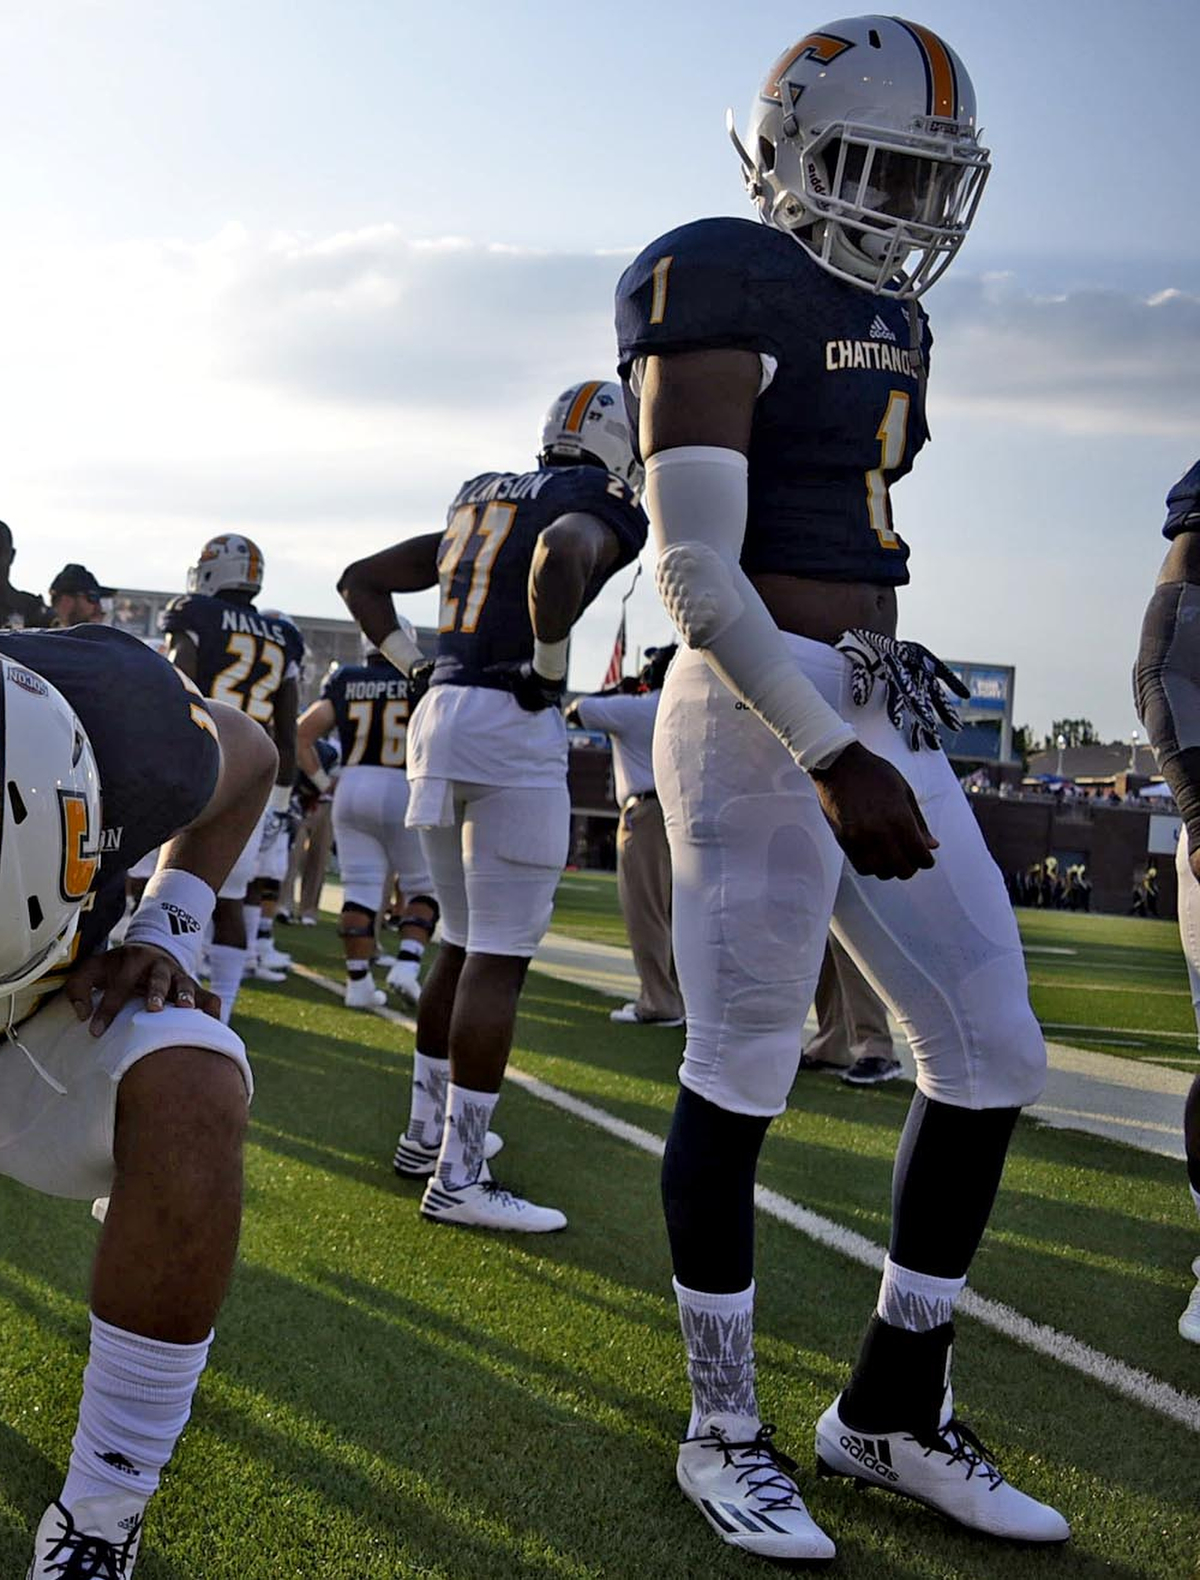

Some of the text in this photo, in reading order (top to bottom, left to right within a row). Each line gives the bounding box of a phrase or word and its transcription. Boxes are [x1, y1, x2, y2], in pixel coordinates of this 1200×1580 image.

[649, 256, 673, 324] 1
[865, 389, 910, 548] 1
[221, 609, 287, 648] NALLS
[209, 632, 285, 722] 22
[347, 701, 409, 766] 76
[161, 902, 201, 931] adidas
[840, 1435, 900, 1482] adidas
